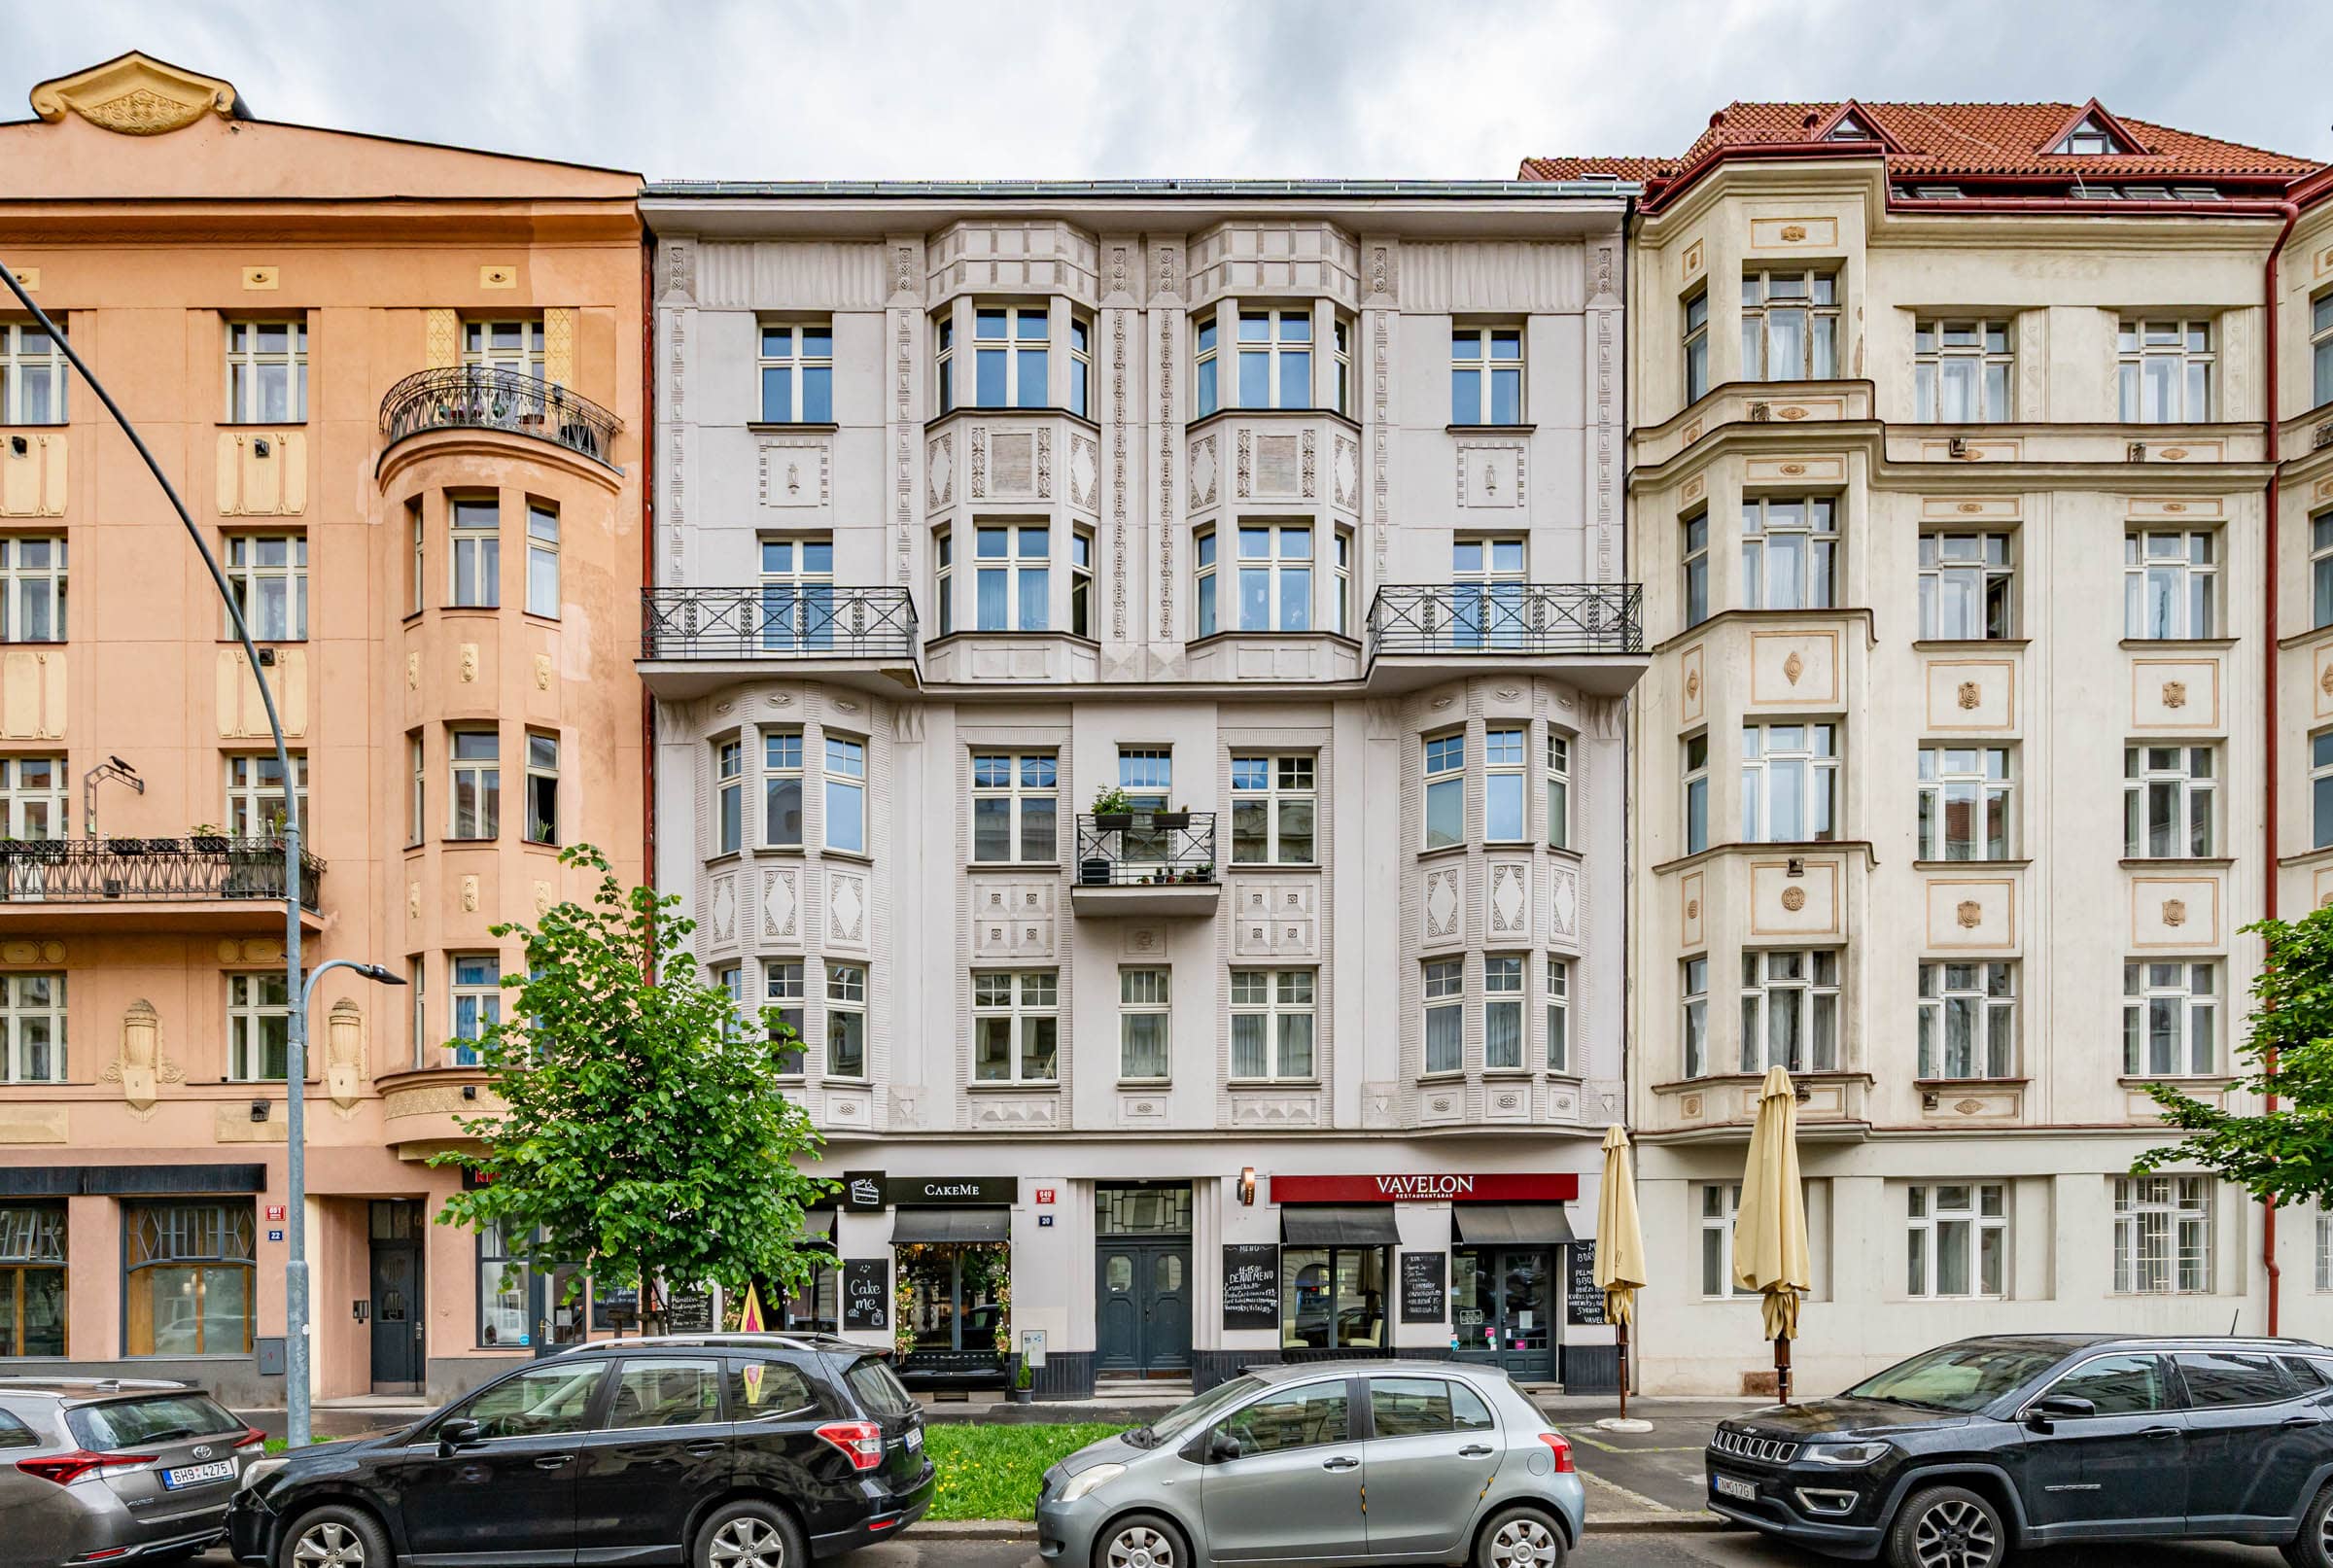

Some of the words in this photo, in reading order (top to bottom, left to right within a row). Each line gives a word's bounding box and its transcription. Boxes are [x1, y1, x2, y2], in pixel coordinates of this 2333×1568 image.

[1375, 1175, 1474, 1194] VAVELON
[851, 1279, 881, 1297] Cake
[855, 1299, 877, 1310] me
[174, 1469, 194, 1482] 6H9
[203, 1463, 227, 1477] 4275
